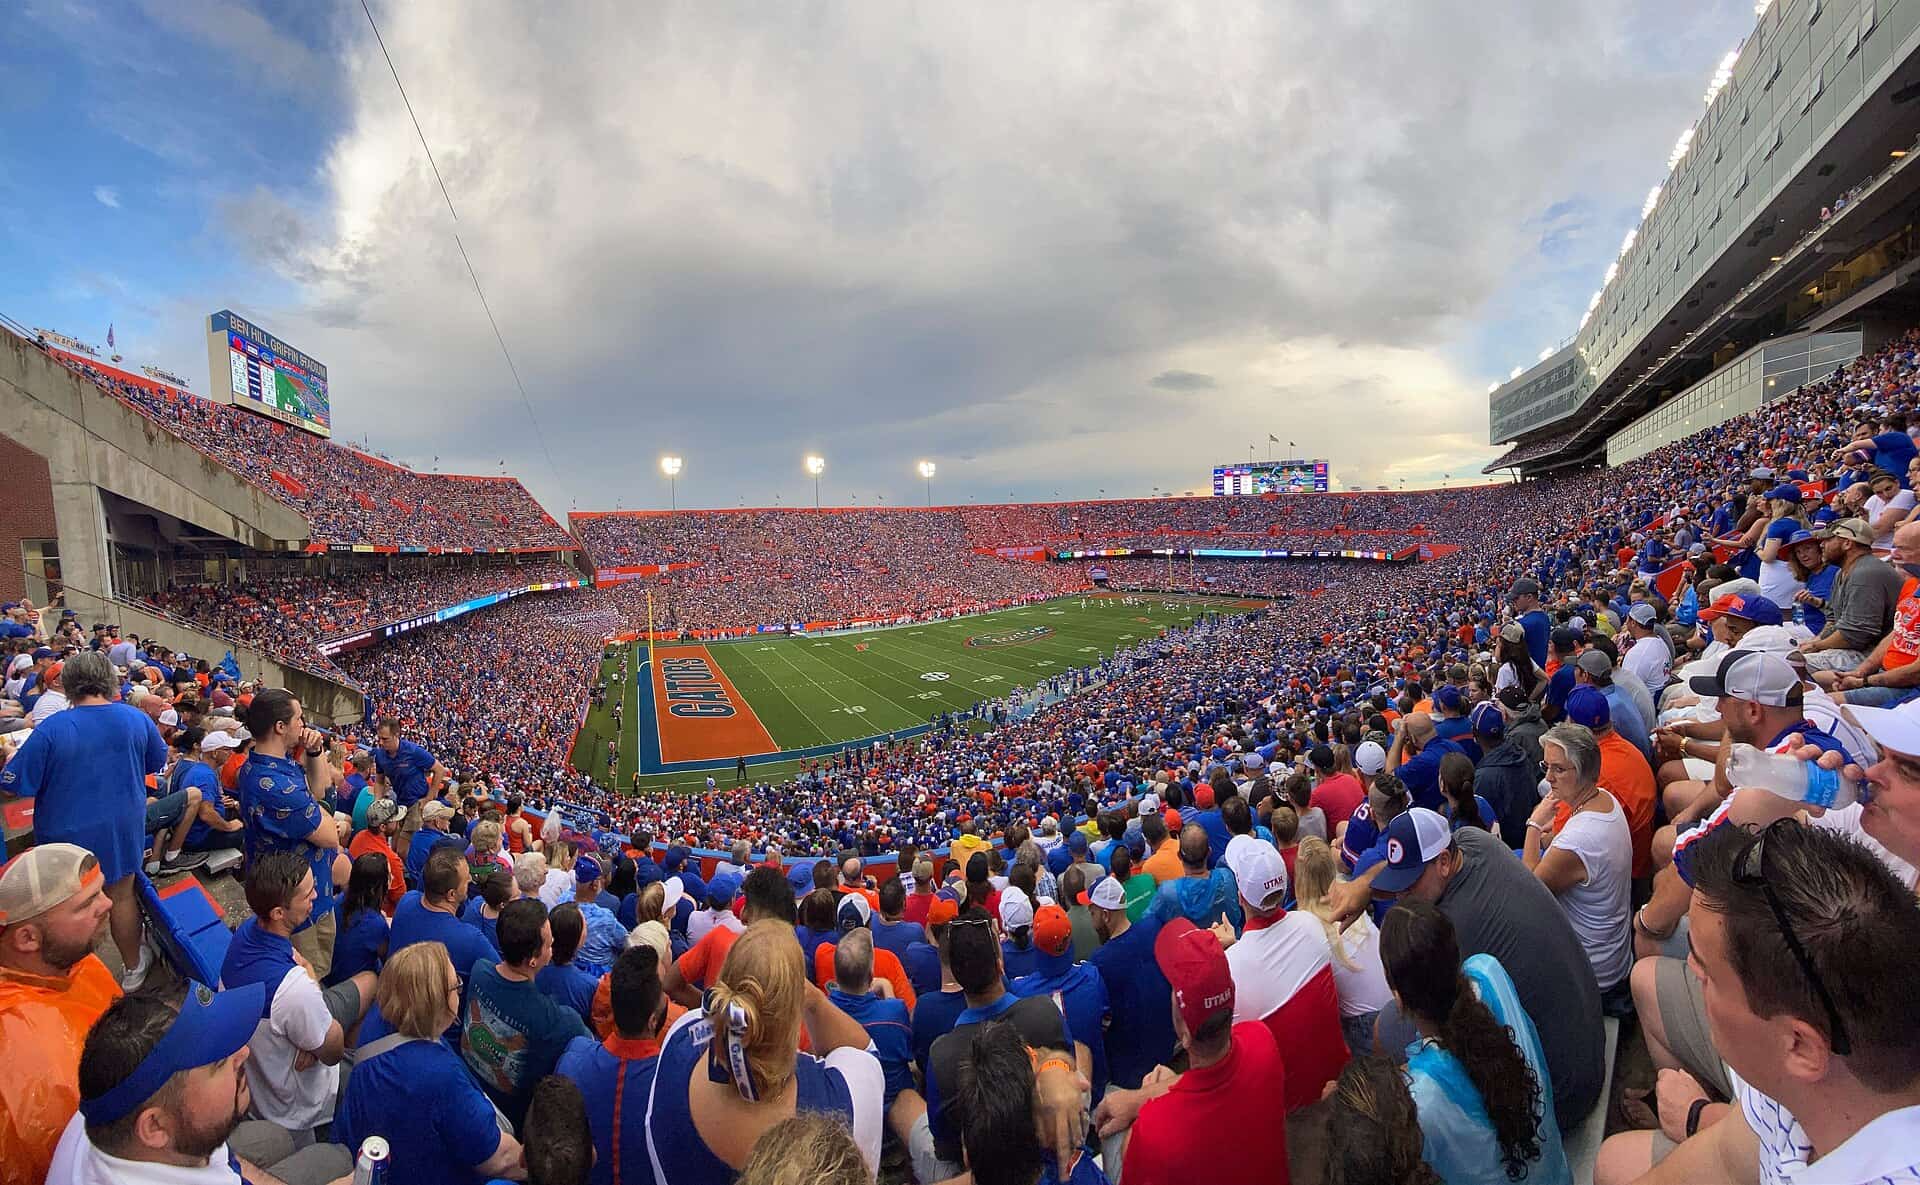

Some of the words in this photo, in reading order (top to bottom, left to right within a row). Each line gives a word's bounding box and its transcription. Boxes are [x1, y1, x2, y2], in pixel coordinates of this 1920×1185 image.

[229, 314, 249, 337] BEN
[250, 327, 270, 348] HILL
[270, 338, 299, 363] GRIFFIN
[299, 354, 328, 382] STADIUM
[330, 544, 351, 552] NISSAN
[660, 657, 738, 719] GATORS
[1389, 843, 1398, 858] F
[1263, 875, 1284, 890] UTAH
[1203, 987, 1232, 1009] UTAH
